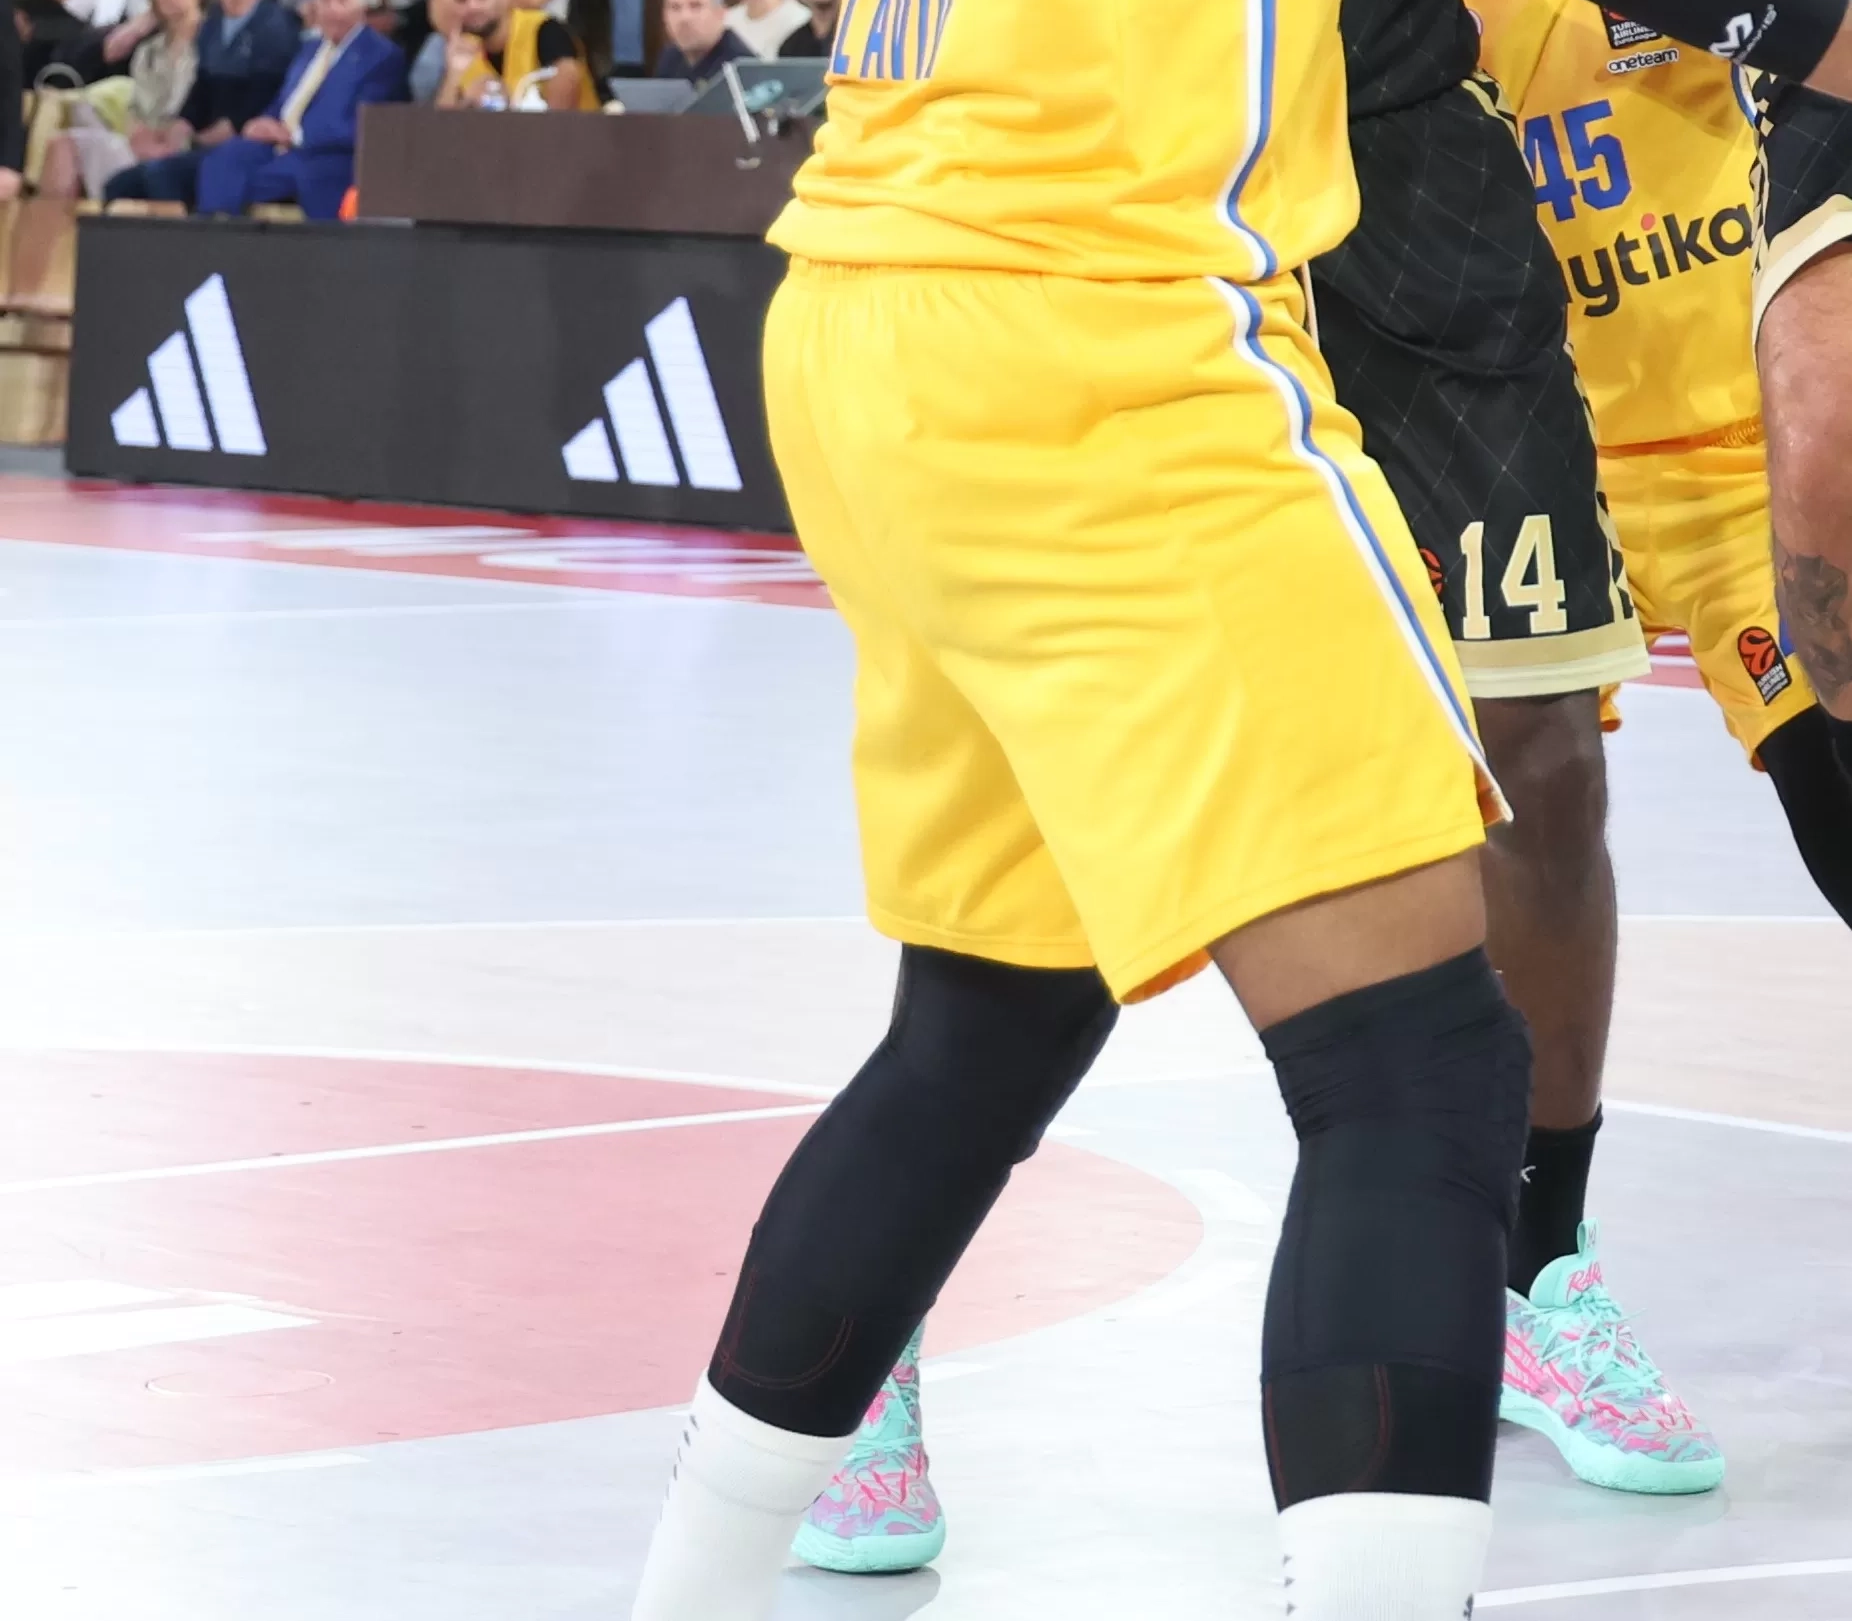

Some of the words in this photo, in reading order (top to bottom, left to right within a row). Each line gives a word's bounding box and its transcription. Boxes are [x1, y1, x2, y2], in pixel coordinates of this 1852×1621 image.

[1608, 49, 1679, 72] oneteam
[1523, 99, 1632, 222] 45
[1565, 203, 1754, 318] ytika
[1459, 513, 1568, 640] 14
